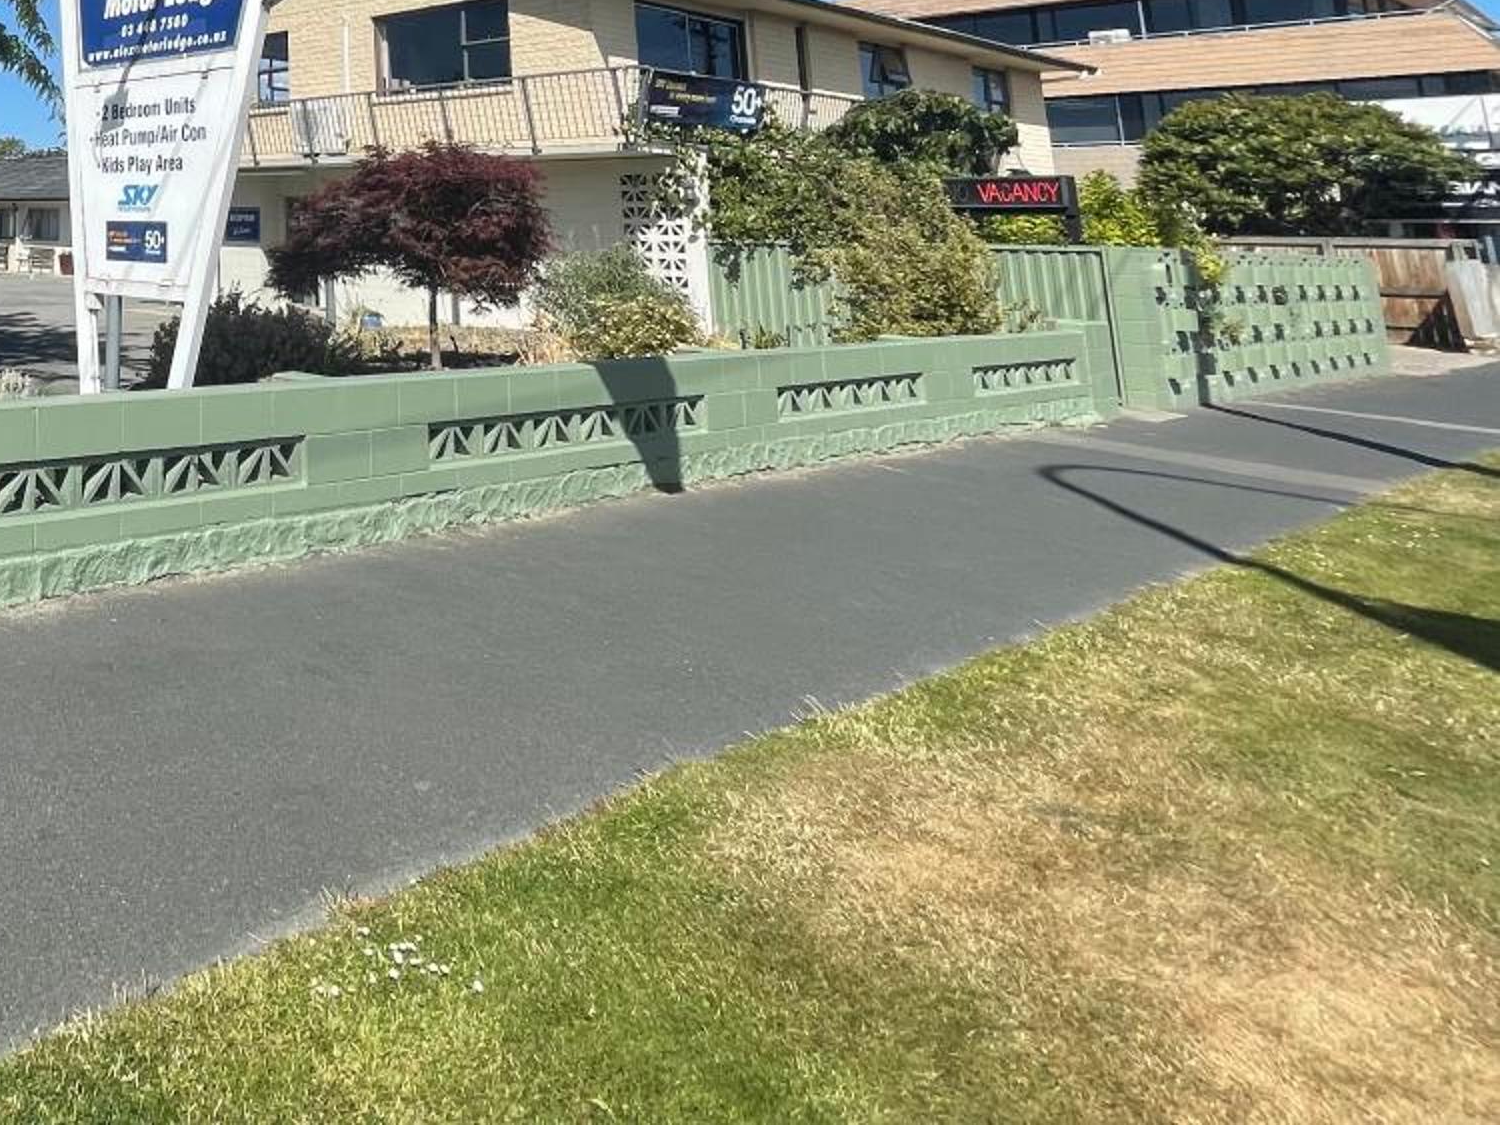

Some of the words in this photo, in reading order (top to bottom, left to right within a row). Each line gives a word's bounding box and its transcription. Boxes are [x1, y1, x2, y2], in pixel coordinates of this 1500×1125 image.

[102, 105, 109, 121] 2
[111, 102, 161, 120] Bedroom
[165, 96, 196, 115] Units
[96, 131, 119, 148] Heat
[121, 124, 178, 147] Pump/Air
[181, 123, 207, 142] Con
[102, 156, 125, 174] Kids
[128, 156, 152, 176] Play
[155, 155, 183, 172] Area
[118, 184, 159, 206] SKY
[977, 181, 1059, 203] VACANCY
